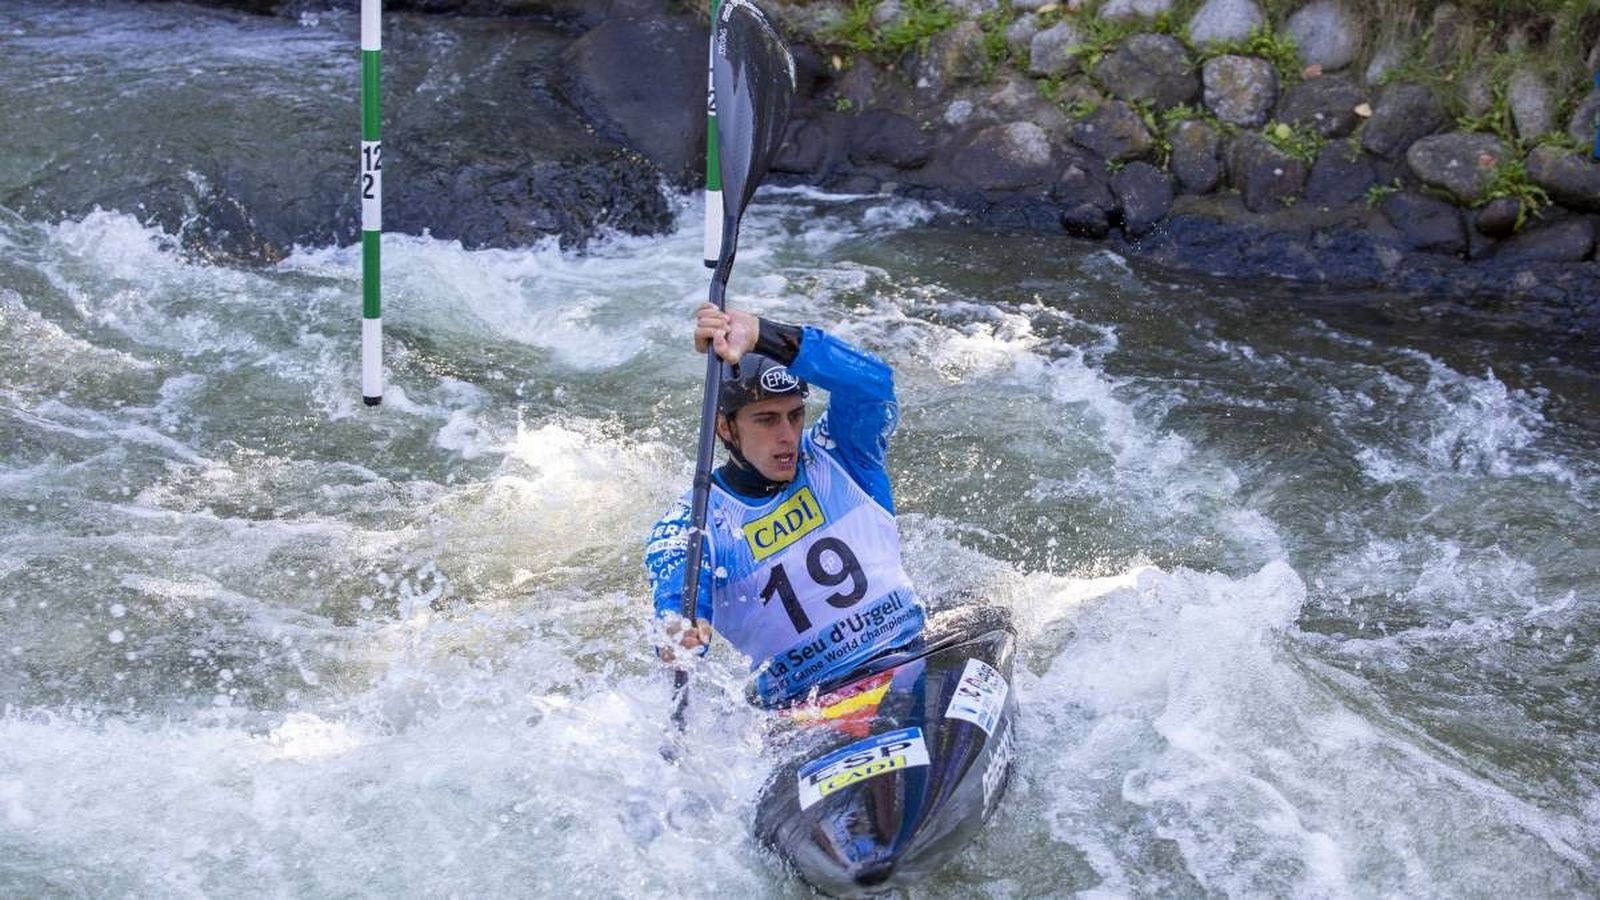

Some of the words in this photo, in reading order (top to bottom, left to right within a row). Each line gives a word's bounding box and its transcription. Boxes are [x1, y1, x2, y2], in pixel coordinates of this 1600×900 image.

[363, 145, 382, 171] 12
[363, 173, 374, 199] 2
[760, 537, 868, 634] 19
[768, 662, 790, 678] La
[787, 637, 827, 668] Seu
[791, 660, 824, 681] Canoe
[823, 638, 860, 663] World
[809, 742, 912, 786] ESP
